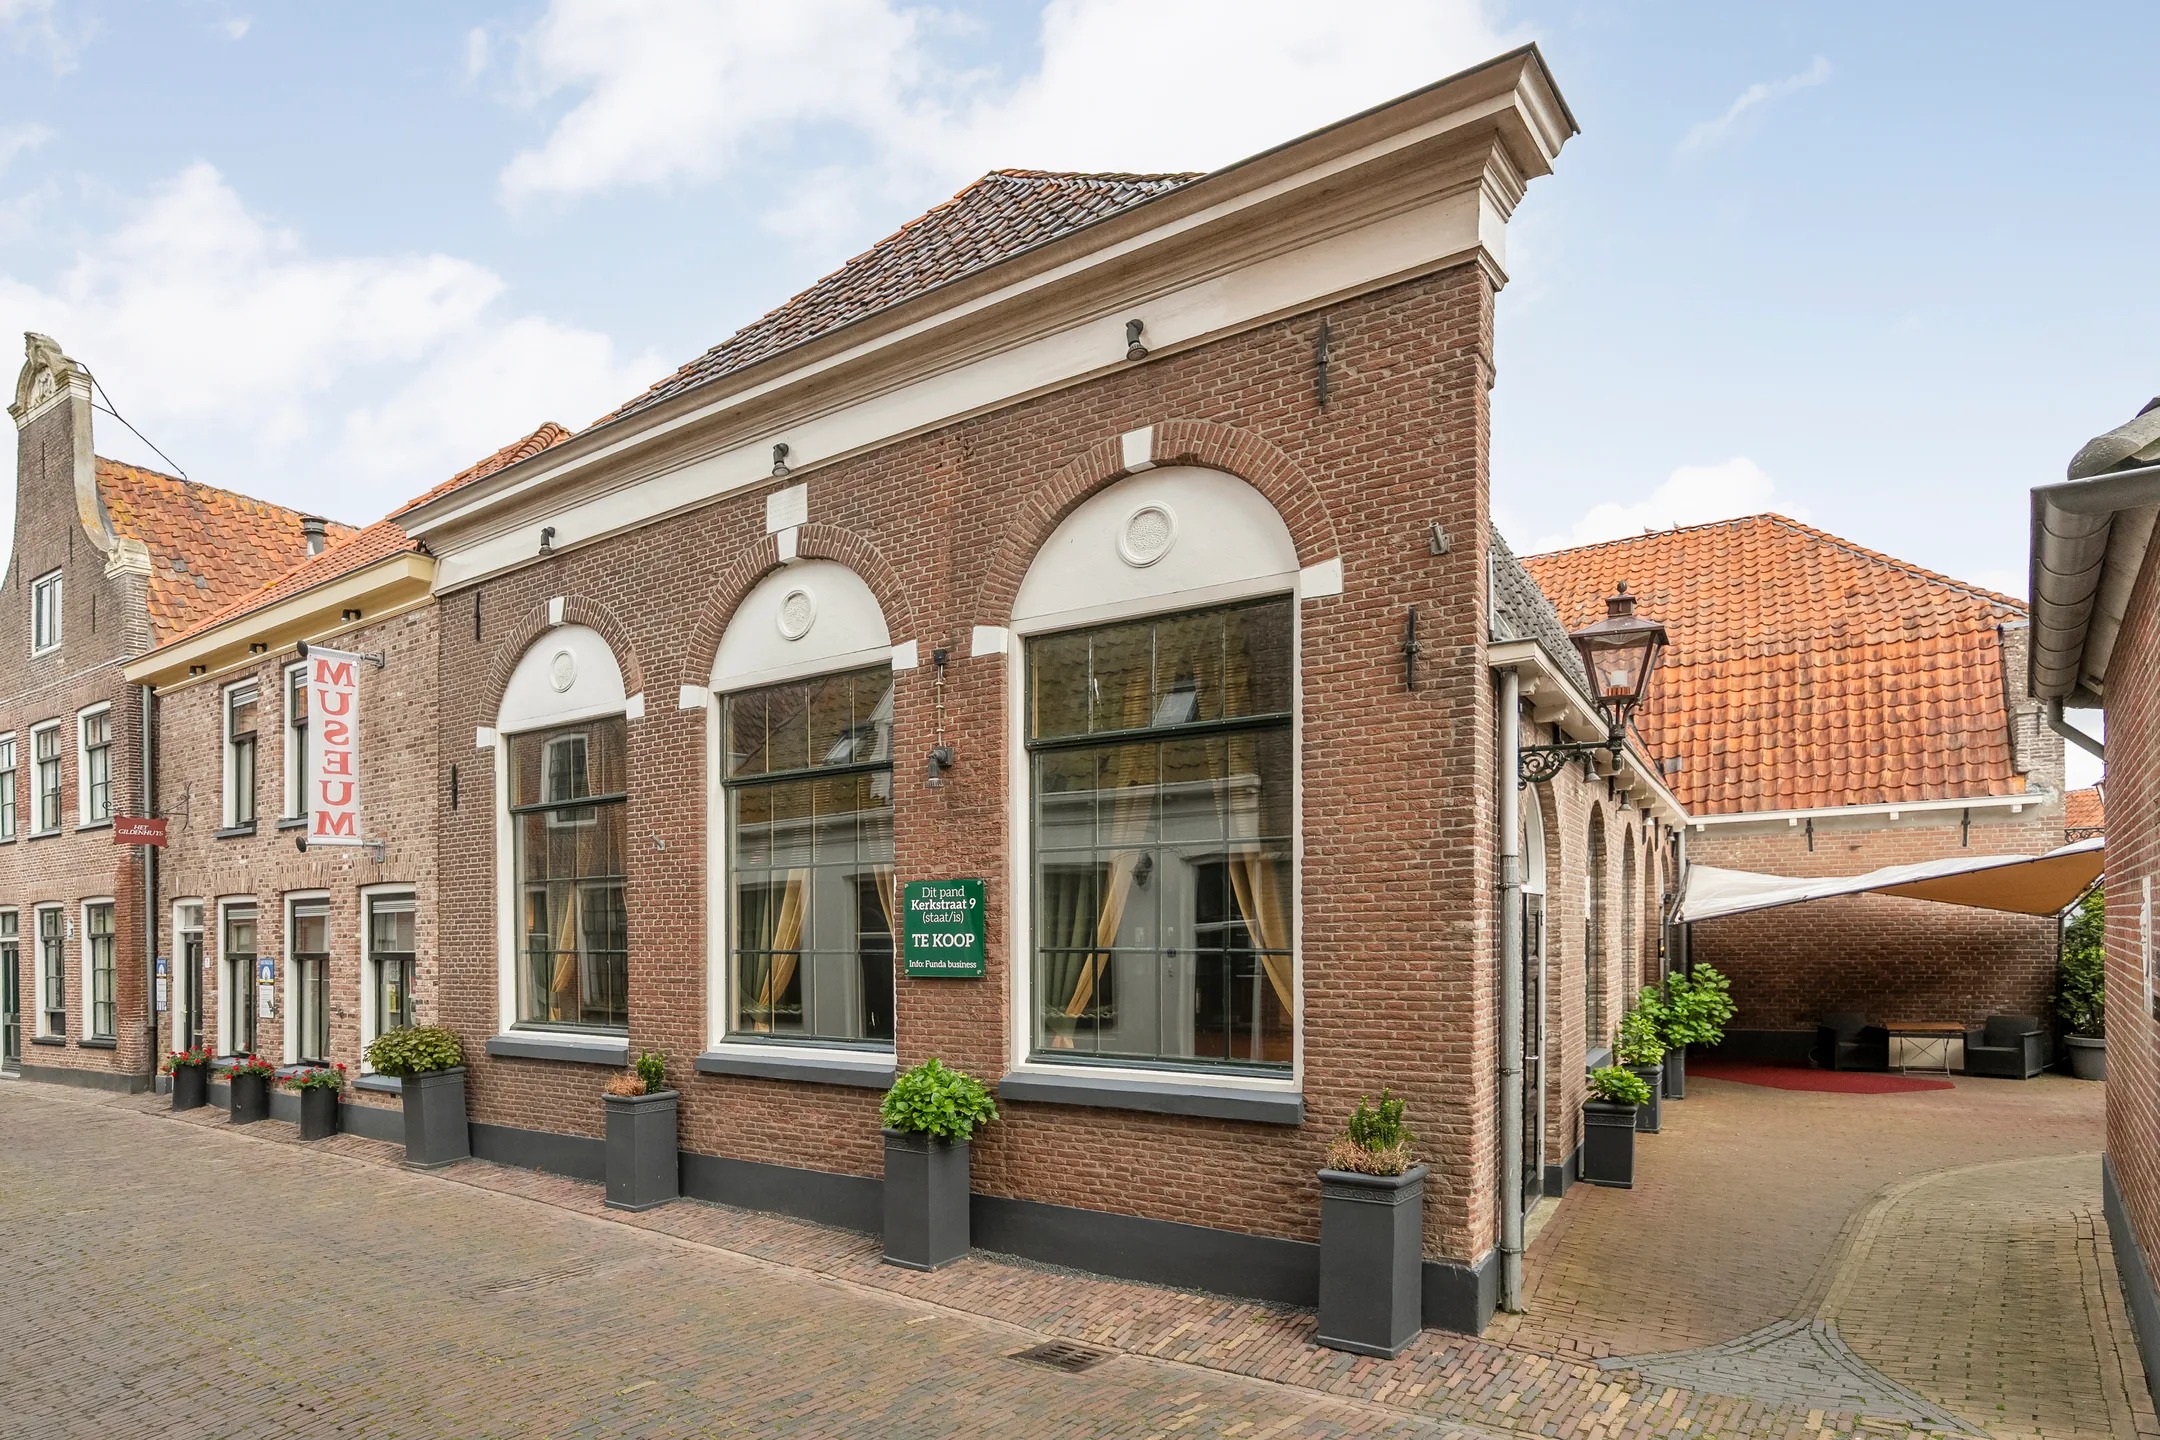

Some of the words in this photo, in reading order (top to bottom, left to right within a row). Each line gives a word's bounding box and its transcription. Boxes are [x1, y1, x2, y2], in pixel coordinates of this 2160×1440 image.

[922, 887, 937, 898] Dit
[939, 885, 965, 899] pand
[911, 899, 967, 911] Kerkstraat
[969, 897, 977, 909] 9
[922, 911, 964, 924] (staat/is)
[911, 933, 930, 948] TE
[932, 933, 976, 948] KOOP
[909, 959, 925, 968] Info:
[925, 960, 947, 969] Funda
[947, 960, 977, 969] business
